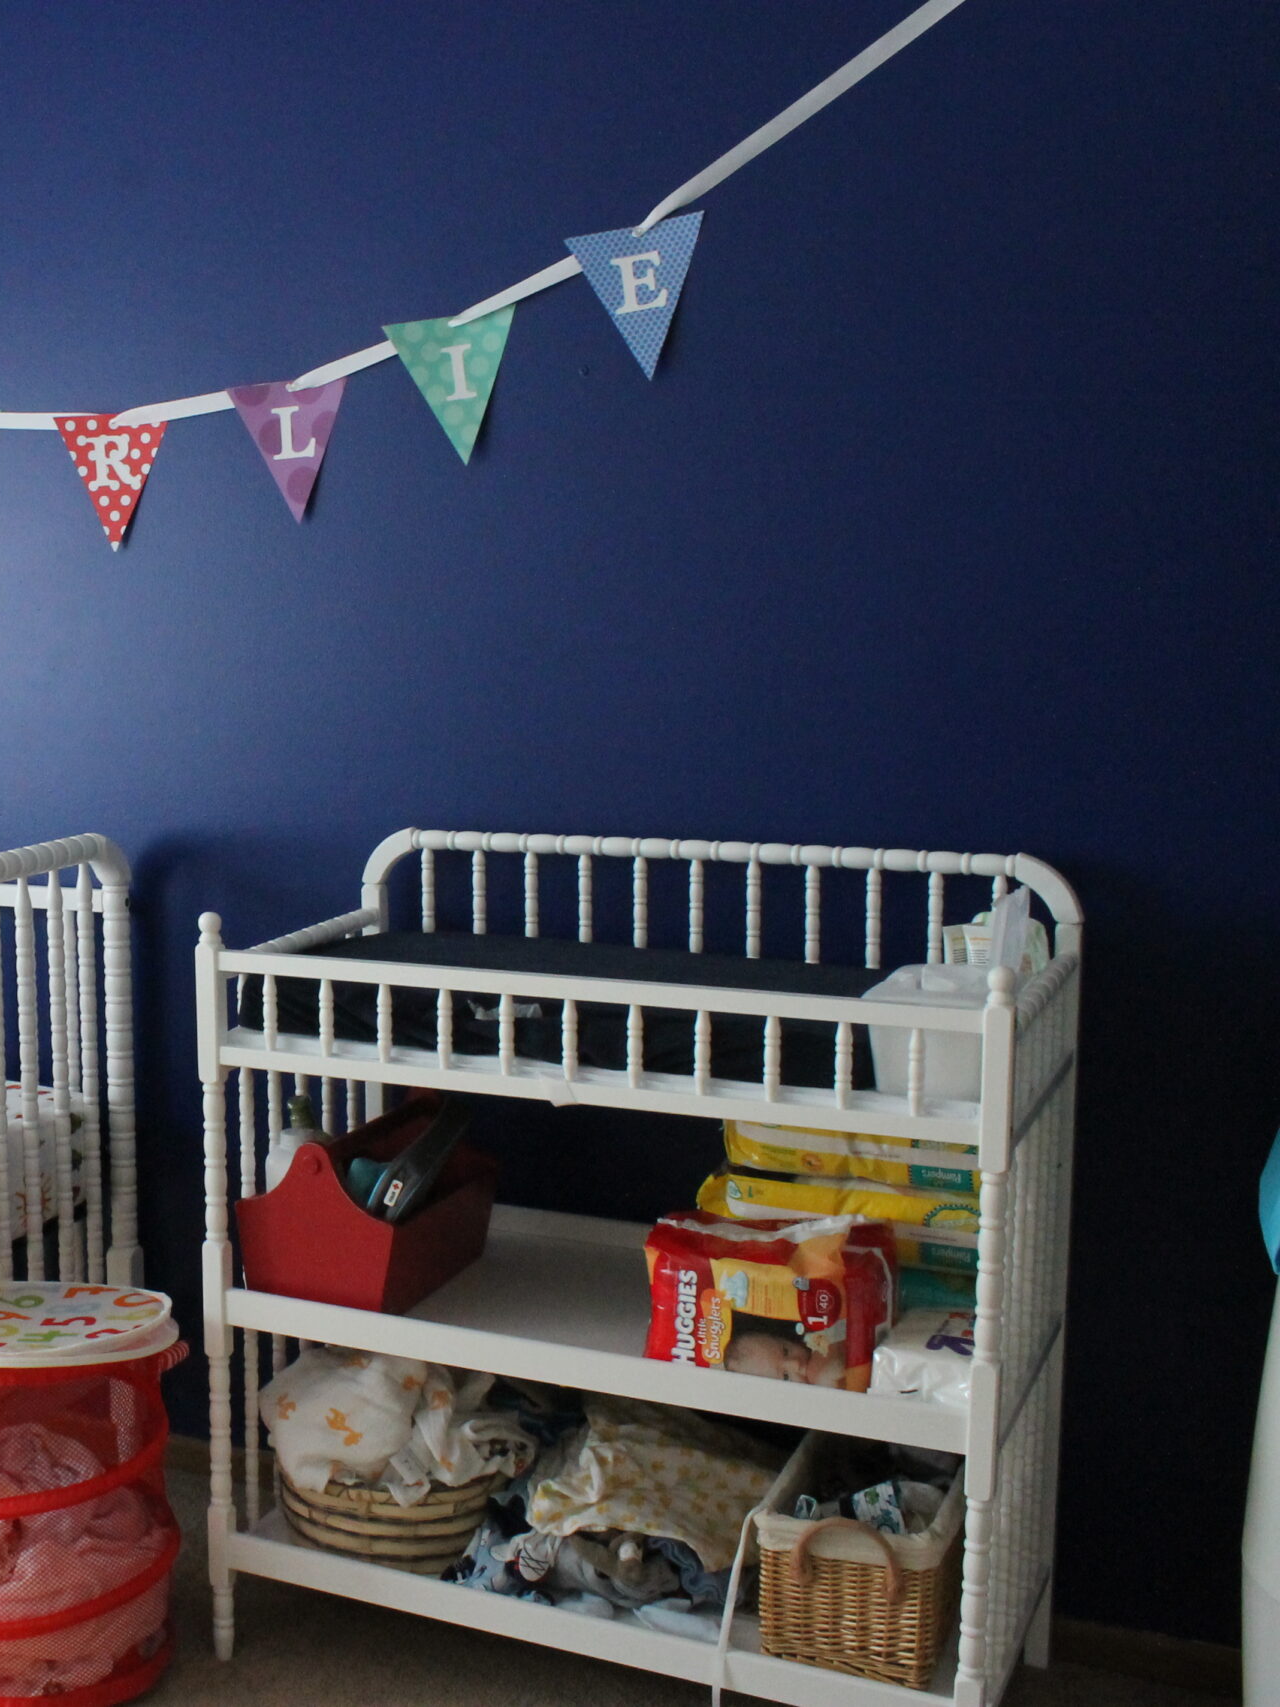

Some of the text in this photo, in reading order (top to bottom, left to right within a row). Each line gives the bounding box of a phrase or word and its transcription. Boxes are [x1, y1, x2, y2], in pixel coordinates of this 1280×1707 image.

[671, 1269, 698, 1366] HUGGIES
[697, 1317, 707, 1345] Little
[704, 1296, 725, 1360] Snugglers
